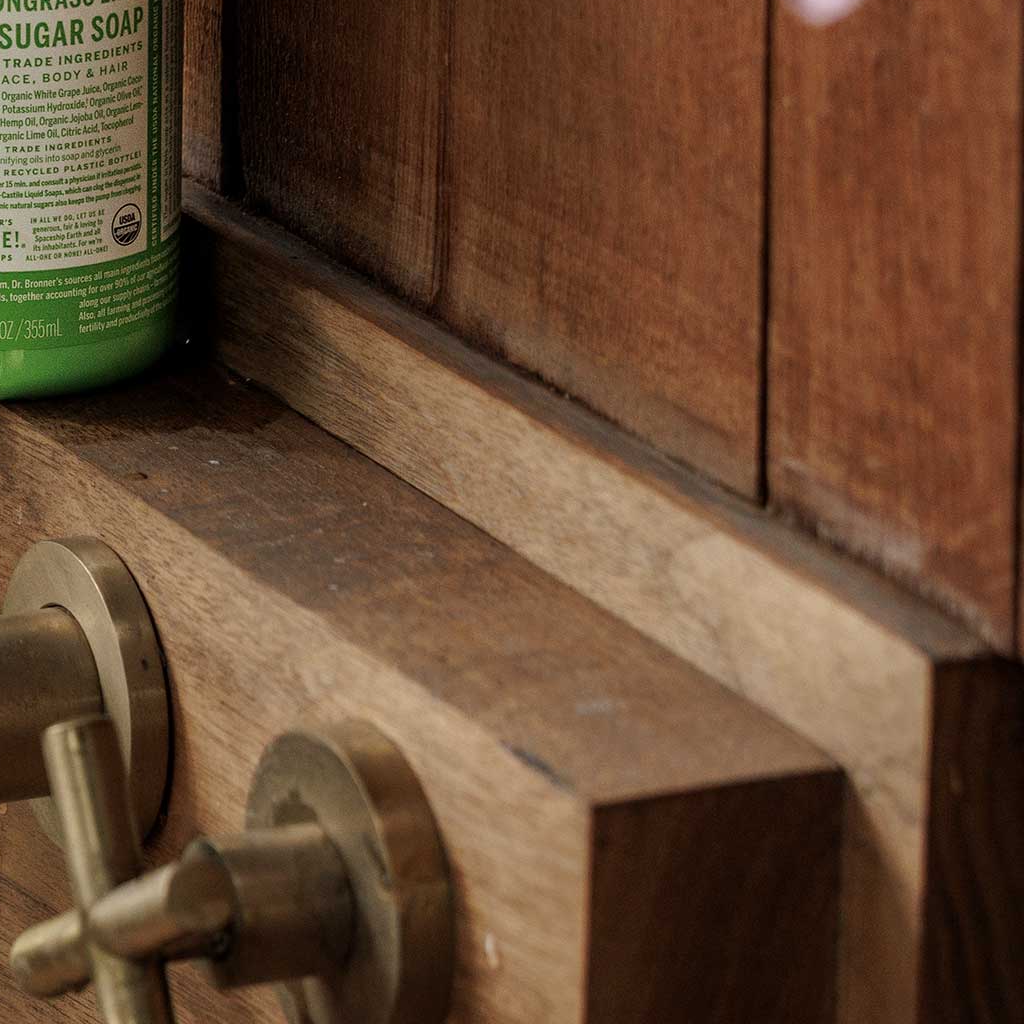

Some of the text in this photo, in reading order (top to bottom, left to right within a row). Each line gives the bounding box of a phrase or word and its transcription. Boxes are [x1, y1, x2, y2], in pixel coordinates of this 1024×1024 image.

[91, 6, 144, 42] SOAP
[3, 57, 52, 68] TRADE
[58, 40, 143, 66] INGREDIENTS
[42, 70, 80, 82] BODY
[86, 68, 94, 78] &
[100, 61, 128, 76] HAIR
[2, 91, 32, 102] Organic
[34, 90, 56, 100] White
[58, 87, 80, 98] Grape
[82, 85, 101, 95] Juice,
[102, 78, 126, 92] Organic
[2, 104, 45, 114] Potassium
[90, 94, 116, 107] Organic
[0, 118, 23, 128] Hemp
[25, 118, 38, 127] Oil,
[40, 116, 68, 127] Organic
[70, 113, 93, 124] Jojoba
[106, 104, 130, 116] Organic
[26, 130, 45, 140] Lime
[61, 127, 82, 137] Citric
[83, 124, 100, 134] Acid,
[101, 116, 134, 131] Tocopherol
[45, 136, 112, 151] INGREDIENTS
[4, 167, 59, 176] RECYCLED
[64, 161, 104, 172] PLASTIC
[108, 150, 142, 166] BOTTLE!
[45, 154, 60, 162] into
[62, 152, 80, 162] soap
[81, 150, 94, 158] and
[119, 213, 136, 225] USDA
[12, 280, 23, 289] Dr.
[25, 276, 62, 289] Bronner's
[64, 274, 92, 286] sources
[94, 271, 102, 280] all
[104, 268, 120, 278] main
[10, 290, 44, 303] together
[46, 286, 86, 300] accounting
[88, 284, 98, 294] for
[100, 282, 113, 292] over
